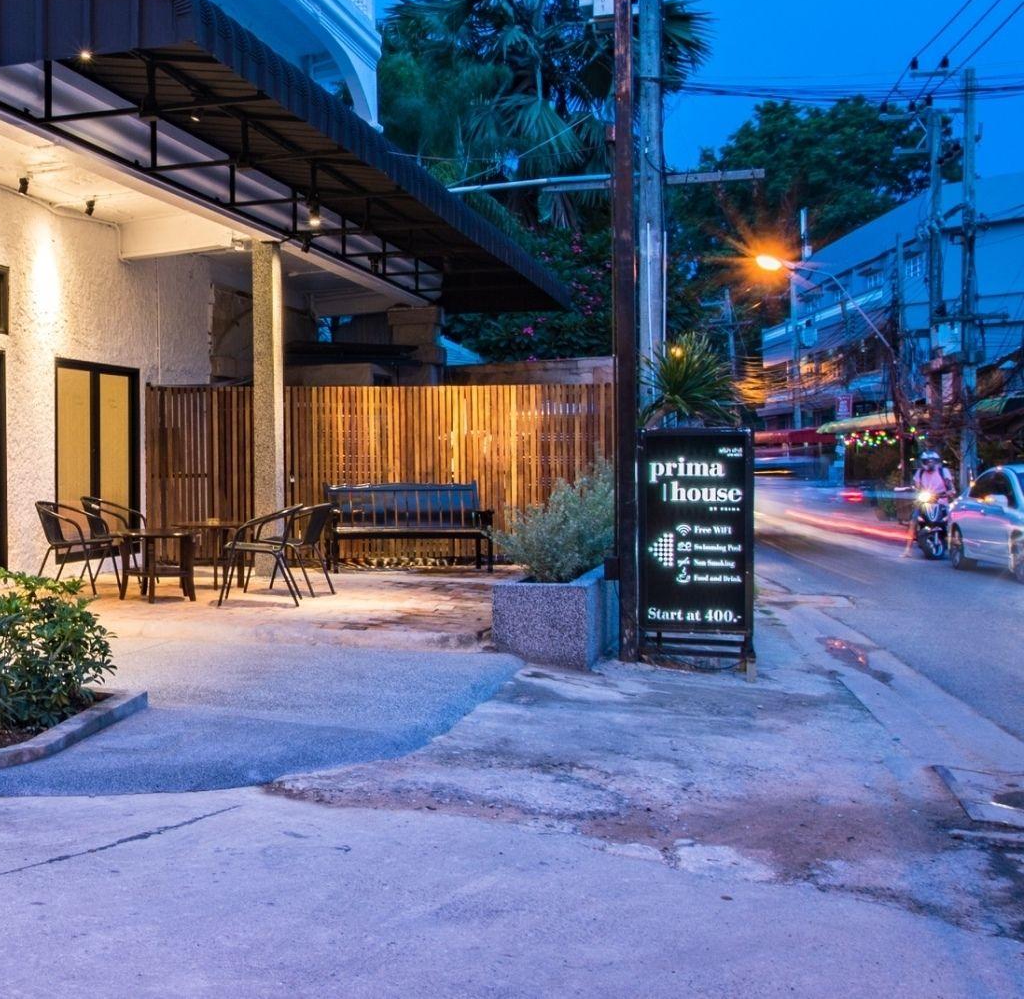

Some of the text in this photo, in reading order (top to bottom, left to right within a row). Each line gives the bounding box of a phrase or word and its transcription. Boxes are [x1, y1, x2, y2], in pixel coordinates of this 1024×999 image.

[649, 457, 725, 484] prima
[670, 481, 743, 502] house
[694, 525, 712, 534] Free
[693, 543, 742, 553] Swimming Pool
[693, 574, 709, 582] Food
[723, 575, 742, 583] Drink
[647, 606, 742, 623] Start at 400.-
